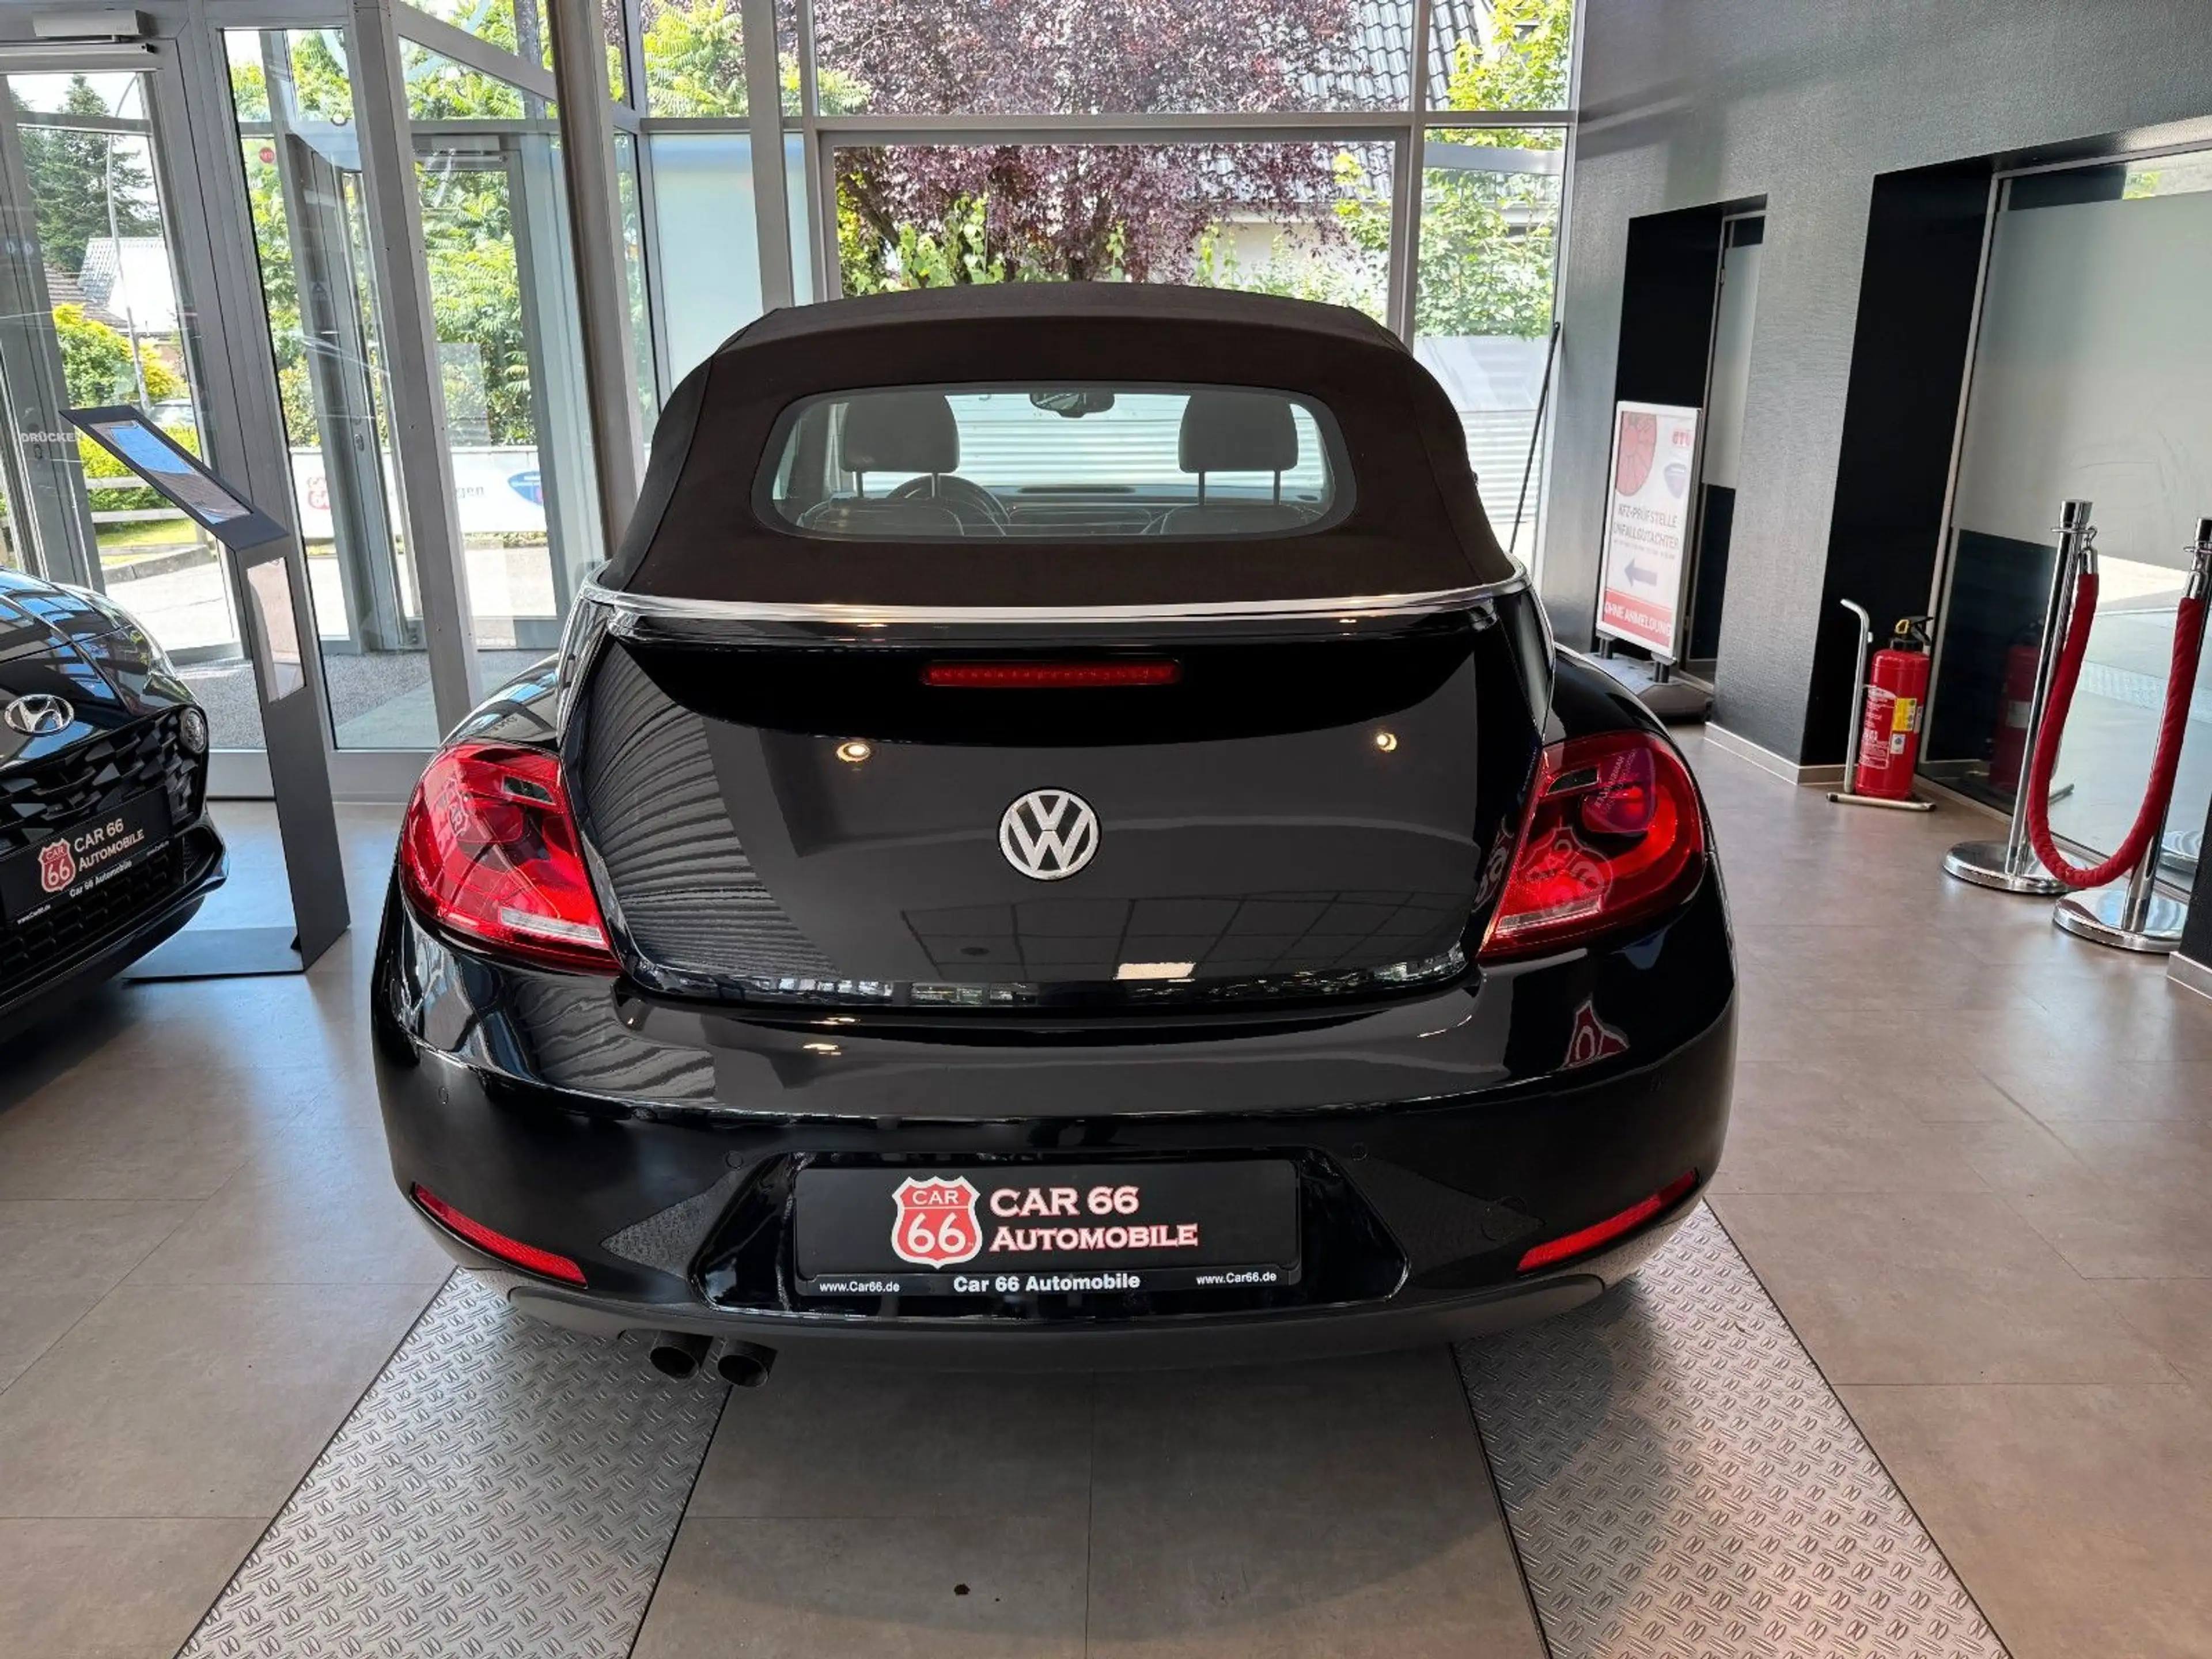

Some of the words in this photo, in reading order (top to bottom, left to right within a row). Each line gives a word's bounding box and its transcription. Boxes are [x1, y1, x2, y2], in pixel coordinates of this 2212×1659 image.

[21, 431, 76, 442] DRÜCKE
[74, 827, 105, 853] CAR
[106, 818, 124, 837] 66
[78, 829, 145, 872] AUTOMOBILE
[46, 845, 65, 860] CAR
[48, 858, 70, 885] 66
[69, 886, 82, 898] Car
[95, 859, 132, 885] Automobile
[912, 1190, 959, 1205] CAR
[989, 1187, 1080, 1218] CAR
[1087, 1185, 1139, 1215] 66
[907, 1212, 966, 1253] 66
[988, 1222, 1199, 1252] AUTOMOBILE
[820, 1281, 900, 1292] www.Car66.de
[953, 1276, 989, 1292] Car
[995, 1275, 1020, 1292] 66
[1025, 1273, 1141, 1291] Automobile
[1196, 1271, 1277, 1285] www.Car66.de
